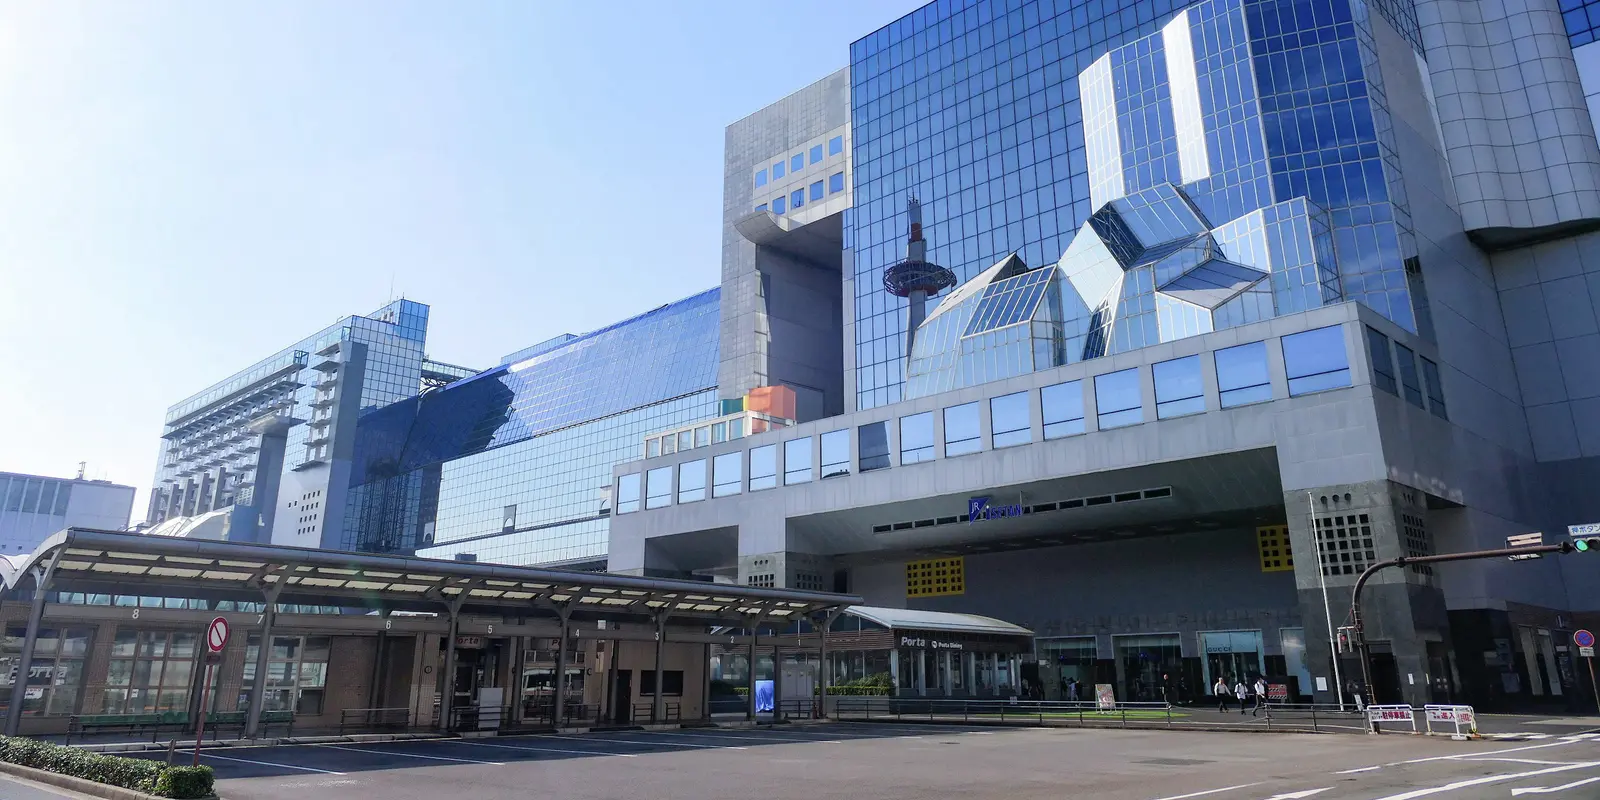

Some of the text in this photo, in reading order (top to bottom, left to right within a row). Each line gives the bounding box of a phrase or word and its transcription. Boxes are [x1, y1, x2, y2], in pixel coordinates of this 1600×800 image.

[971, 502, 980, 514] JR
[132, 608, 139, 619] 8
[257, 614, 264, 624] 7
[386, 620, 391, 630] 6
[487, 624, 493, 634] 5
[575, 628, 580, 638] 4
[654, 631, 659, 641] 3
[456, 636, 479, 645] orta
[730, 635, 735, 644] 2
[901, 636, 926, 647] Porta
